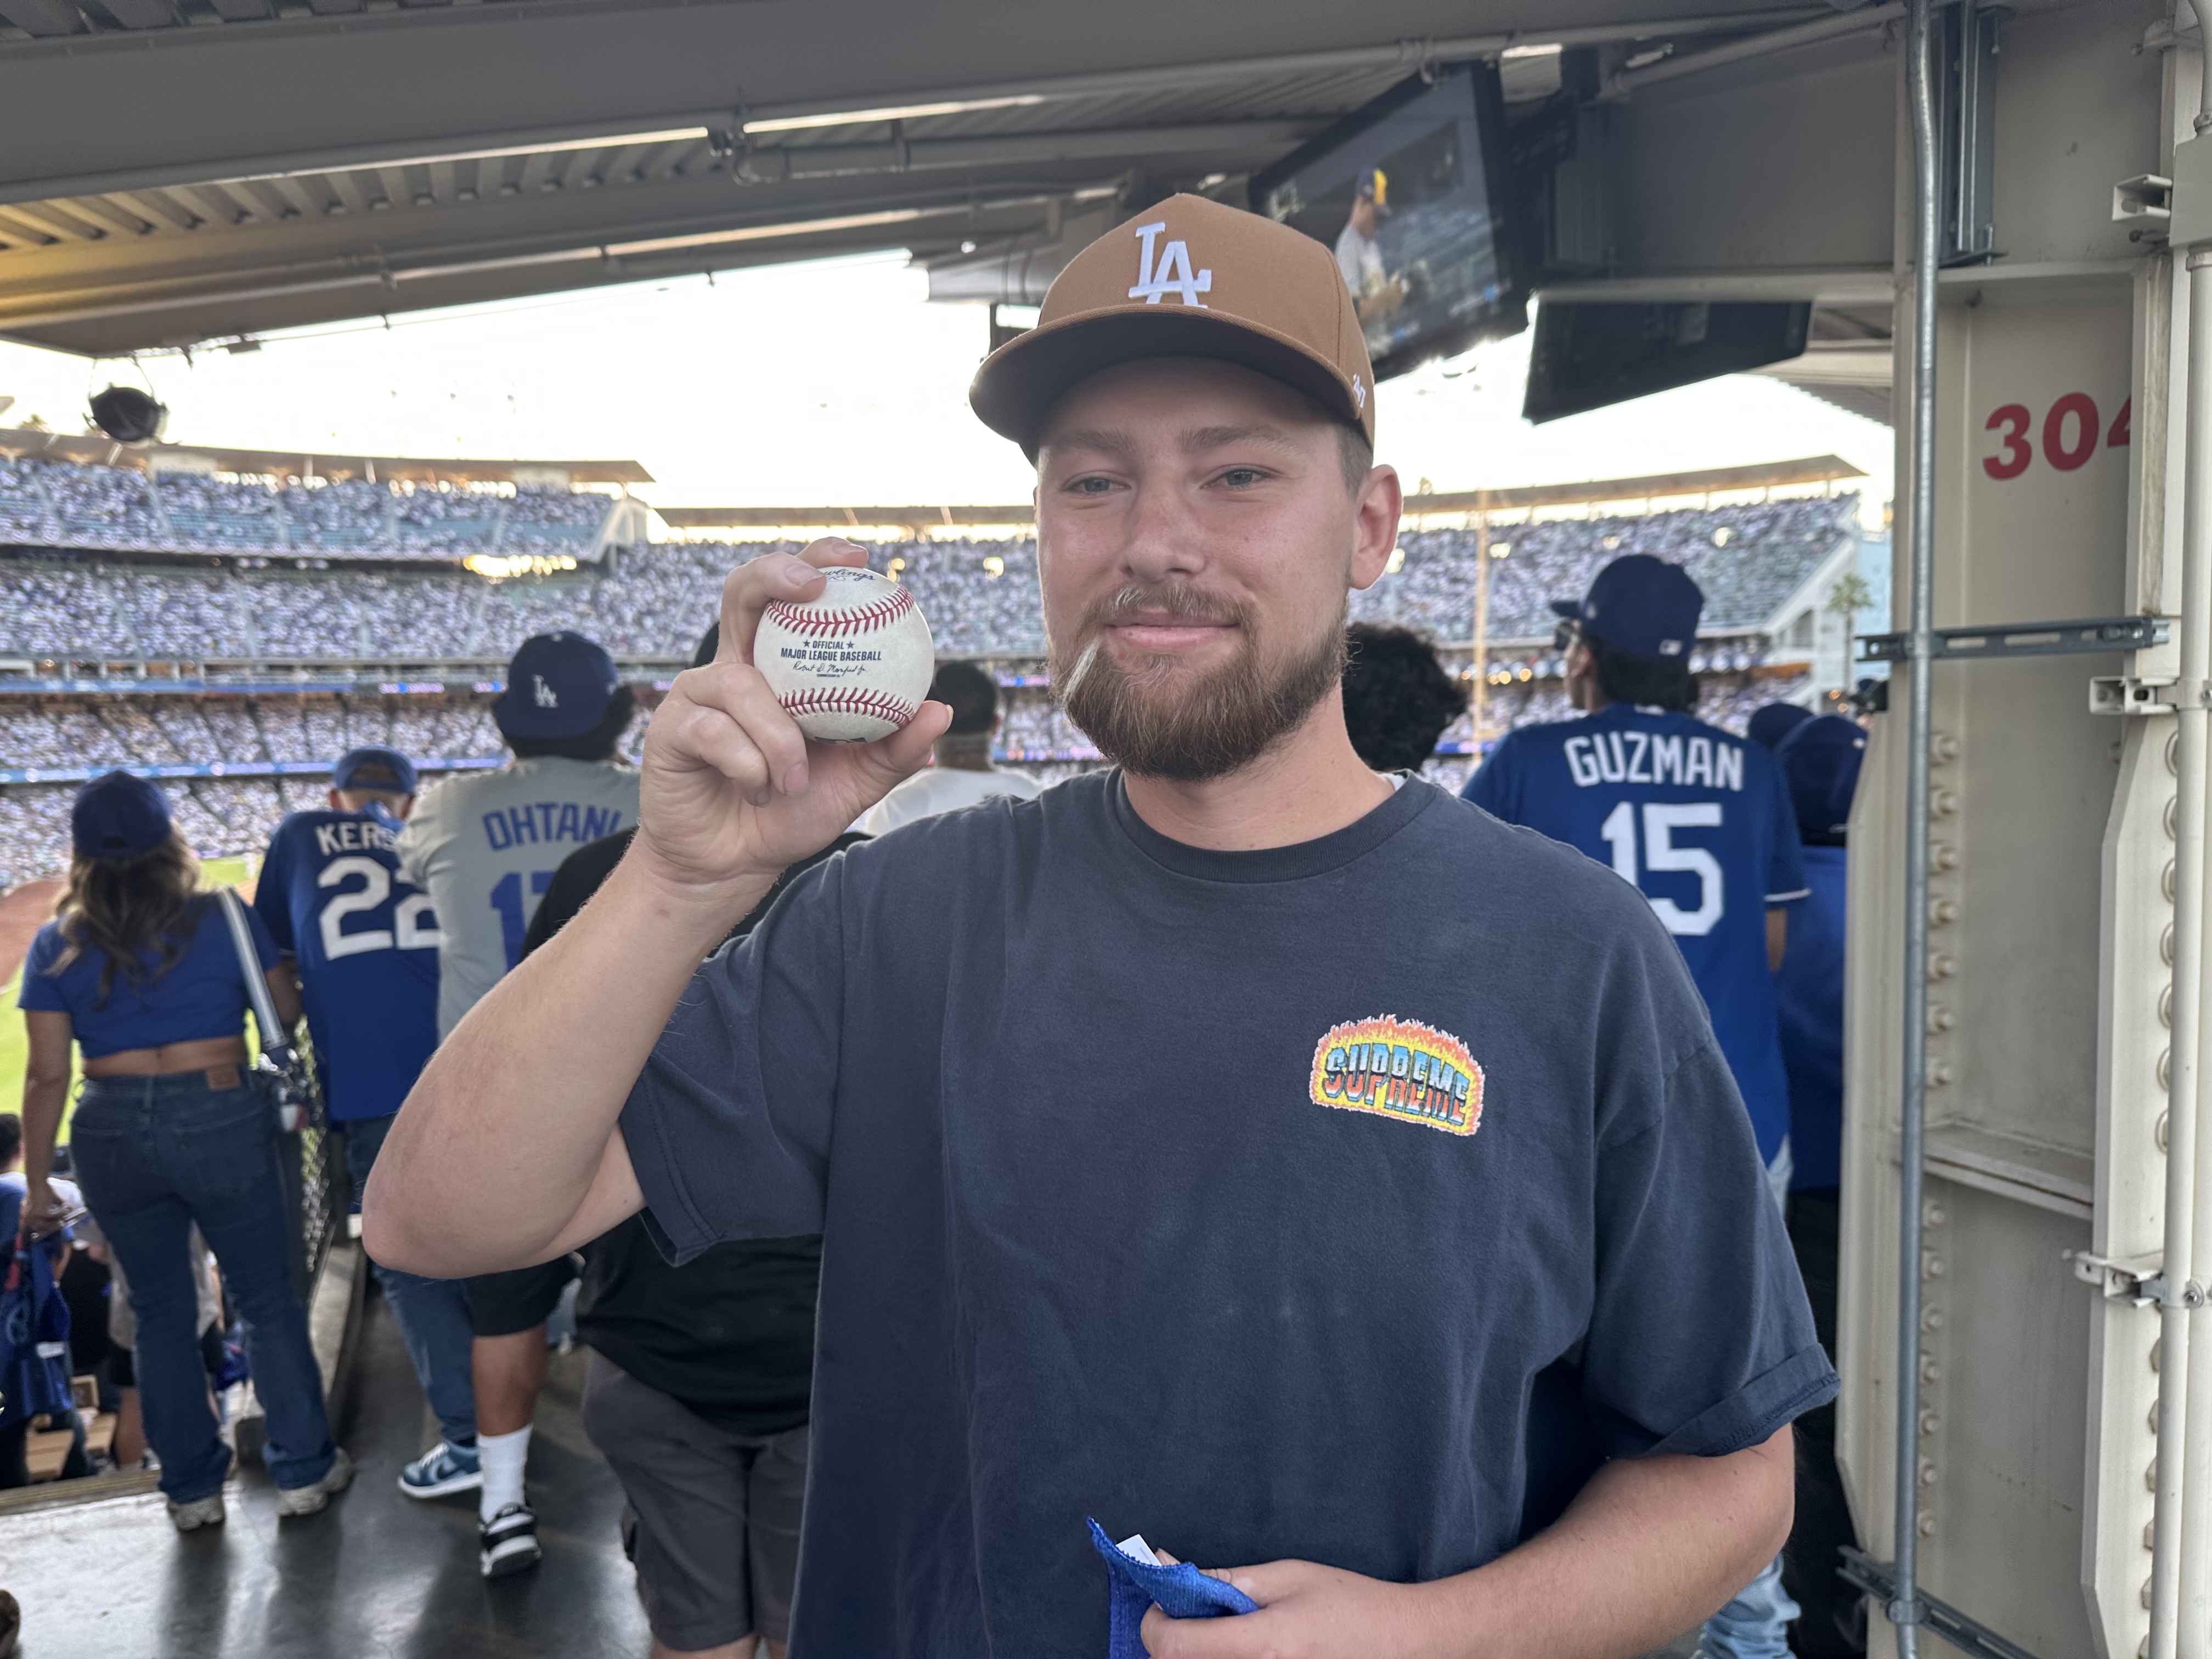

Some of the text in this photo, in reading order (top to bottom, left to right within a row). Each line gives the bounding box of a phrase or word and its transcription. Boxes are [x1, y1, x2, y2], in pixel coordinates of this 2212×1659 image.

[1128, 222, 1212, 308] LA
[824, 568, 876, 582] wlings
[781, 648, 881, 661] MAJOR LEAGUE BASEBALL
[812, 640, 844, 650] OFFICIAL
[1563, 730, 1743, 792] GUZMAN
[314, 822, 398, 856] KERS
[482, 801, 622, 851] OHTANI
[1601, 801, 1723, 935] 15
[318, 856, 440, 960] 22
[490, 871, 556, 974] 1
[1322, 1042, 1469, 1126] SUPREME
